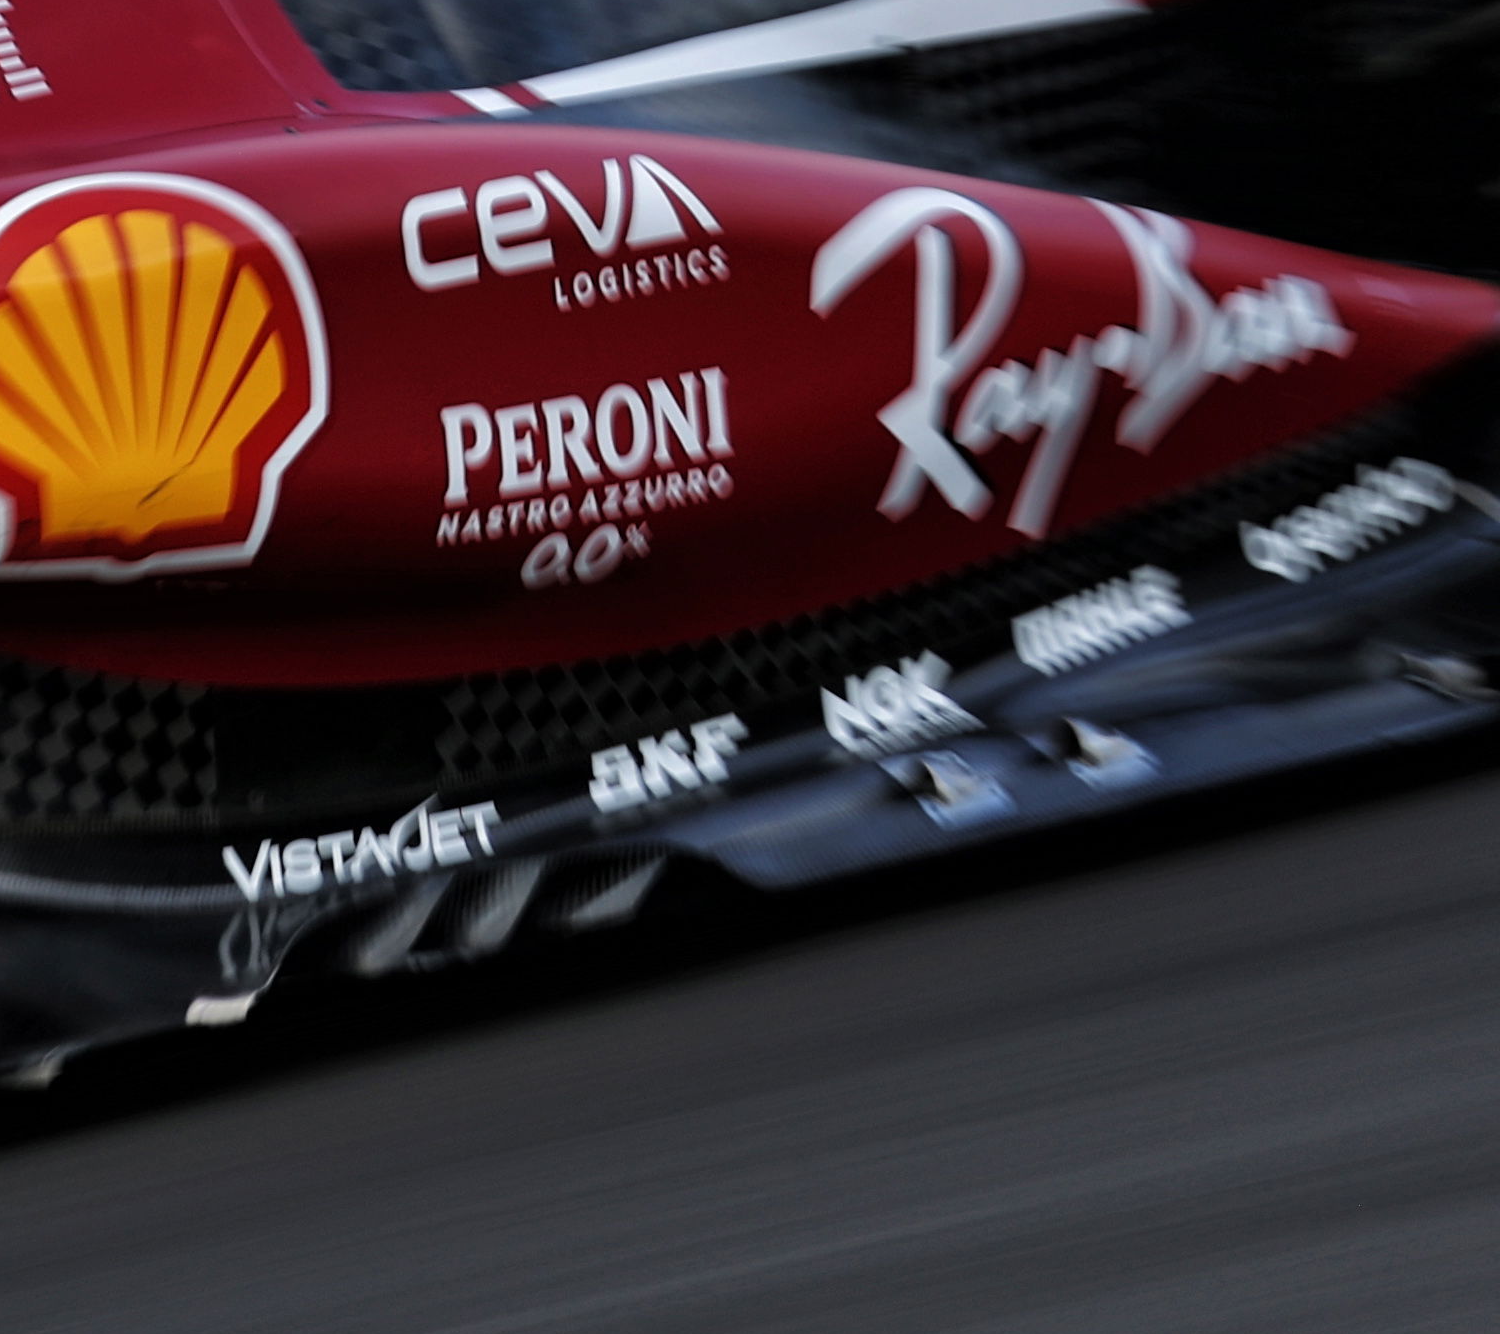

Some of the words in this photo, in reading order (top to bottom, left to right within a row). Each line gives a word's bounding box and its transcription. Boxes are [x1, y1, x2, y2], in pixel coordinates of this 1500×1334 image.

[553, 244, 730, 313] LOGISTICS
[440, 366, 735, 507] PERONI
[436, 493, 573, 548] NASTRO
[578, 463, 735, 525] AZZURRO
[588, 712, 750, 814] SKF
